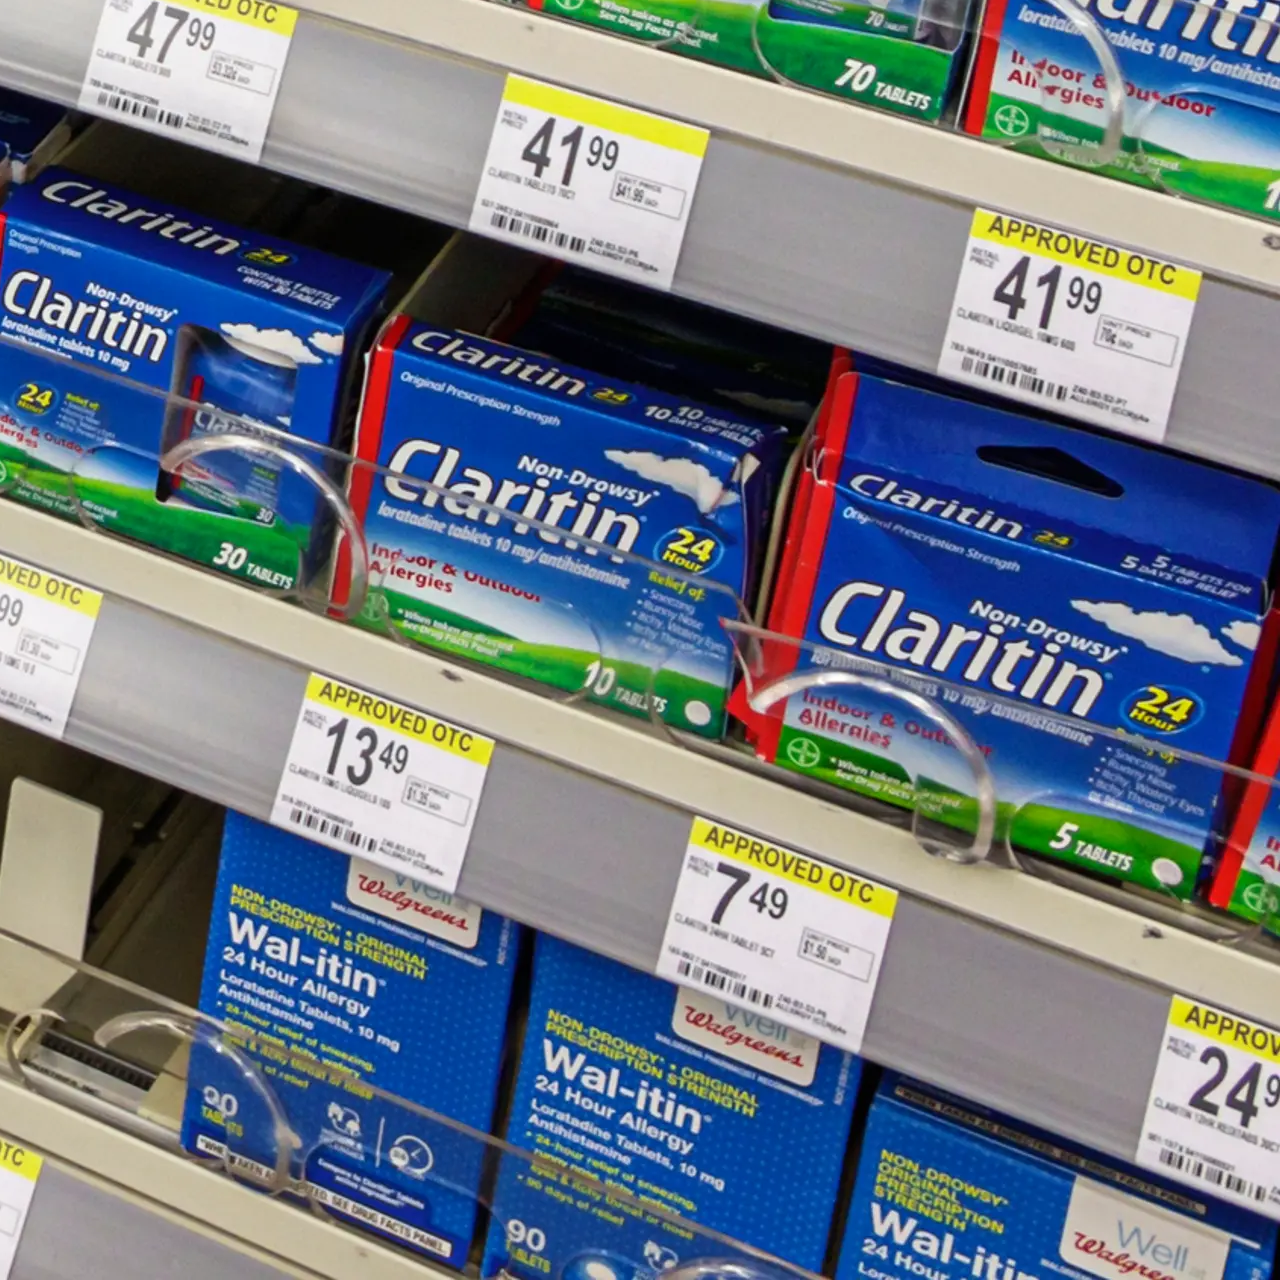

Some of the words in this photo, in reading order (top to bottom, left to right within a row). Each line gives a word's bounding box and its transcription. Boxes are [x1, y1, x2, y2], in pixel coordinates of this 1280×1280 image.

[835, 59, 875, 92] 70
[873, 78, 931, 111] TABLETS
[3, 270, 168, 362] Claritin
[819, 582, 1105, 718] Claritin
[320, 683, 427, 734] APPROVED
[432, 721, 473, 752] OTC
[1144, 686, 1192, 718] 24
[703, 825, 824, 884] APPROVED
[829, 868, 875, 904] OTC
[1075, 840, 1134, 871] TABLETS
[227, 912, 377, 998] Wal-itin
